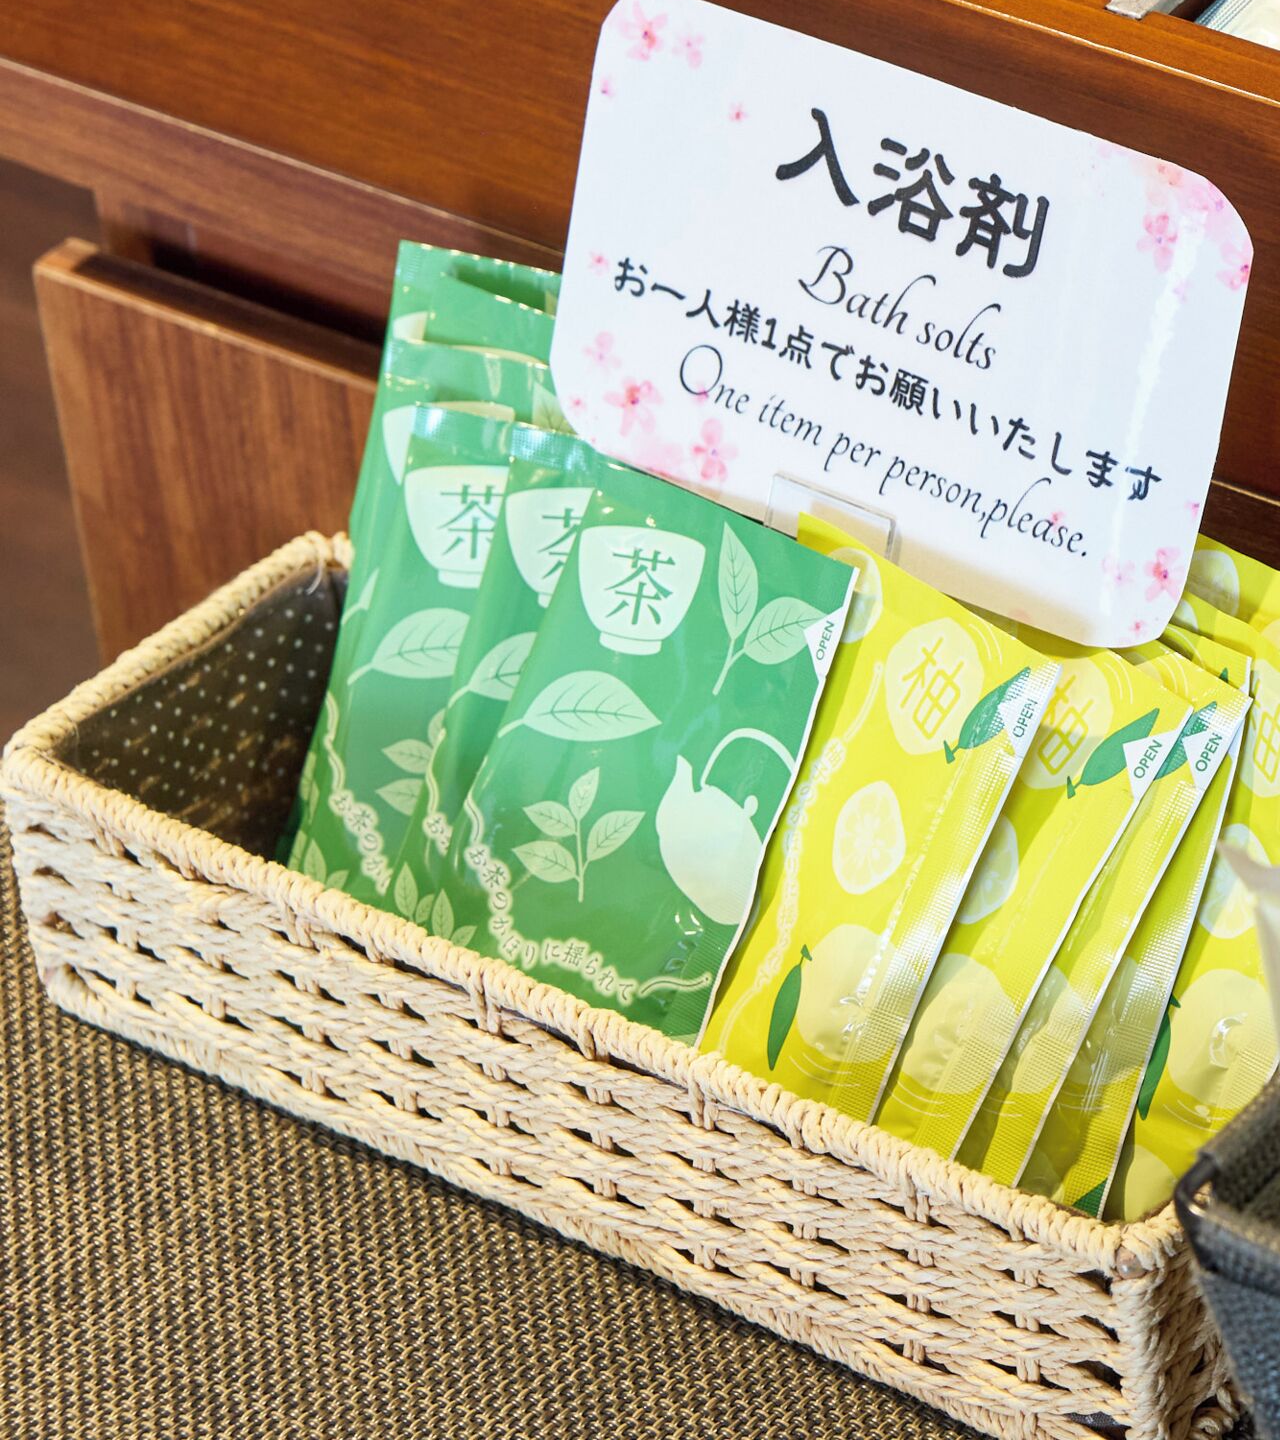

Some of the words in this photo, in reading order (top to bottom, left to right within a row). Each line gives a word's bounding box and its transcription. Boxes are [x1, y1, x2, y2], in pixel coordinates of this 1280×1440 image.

[774, 106, 1050, 279] 入浴剤
[796, 244, 938, 338] Bath
[916, 302, 1003, 372] solts
[613, 256, 1164, 504] お一人様1点でお願いいたします
[679, 343, 751, 417] One
[756, 393, 824, 447] item
[828, 426, 883, 478] per
[602, 546, 678, 627] 茶
[814, 619, 837, 662] OPEN
[900, 635, 961, 741] 柚
[1012, 697, 1039, 740] OPEN
[1132, 738, 1164, 780] OPEN
[1194, 730, 1224, 773] OPEN
[467, 846, 637, 1003] お茶のかほりに揺られて
